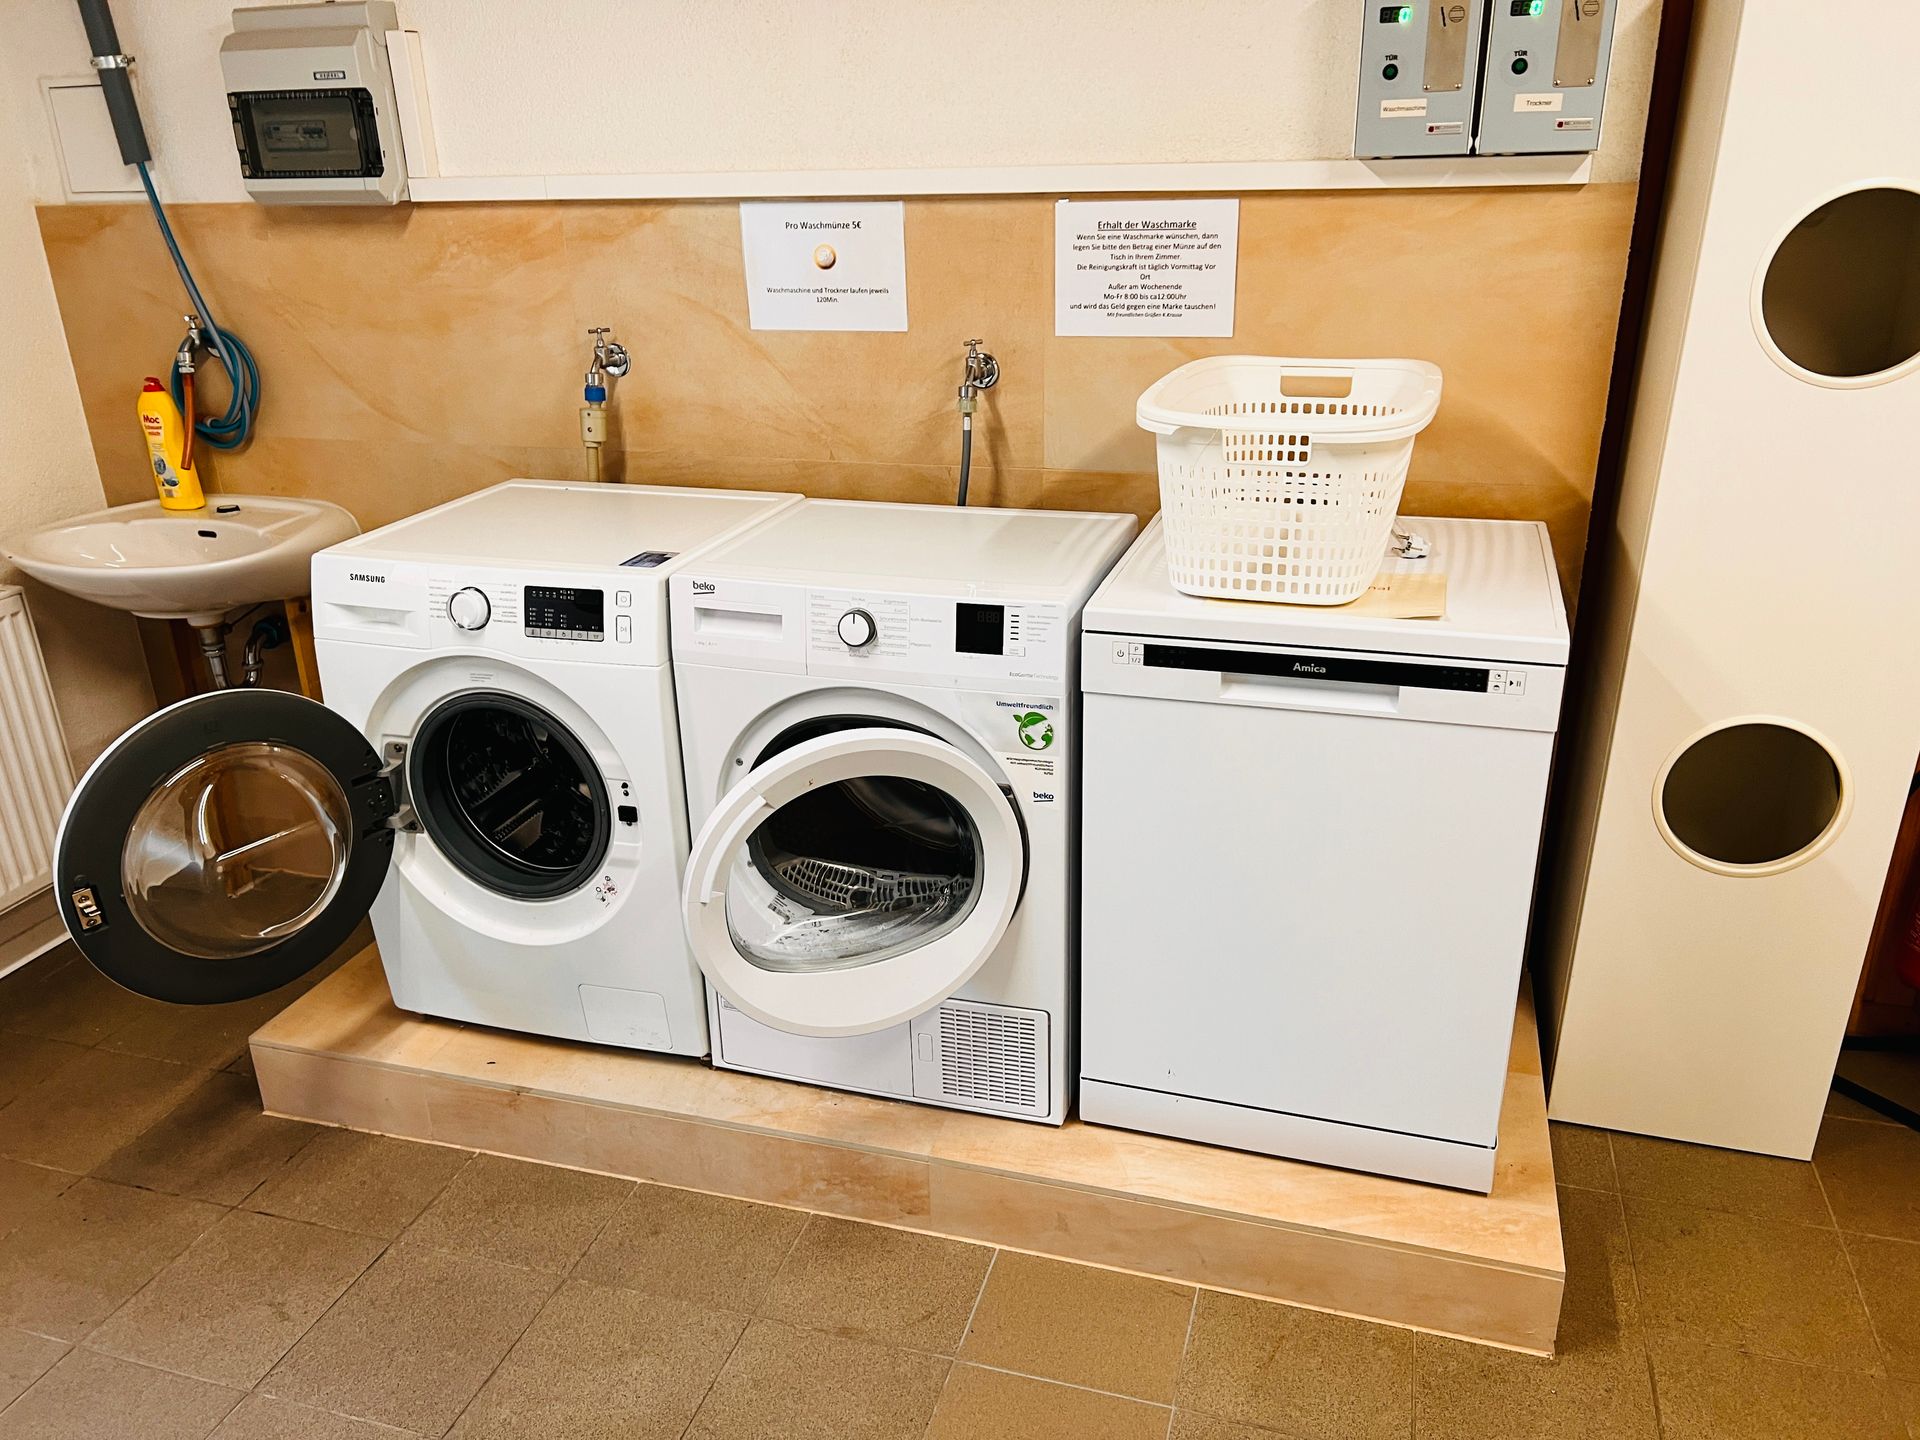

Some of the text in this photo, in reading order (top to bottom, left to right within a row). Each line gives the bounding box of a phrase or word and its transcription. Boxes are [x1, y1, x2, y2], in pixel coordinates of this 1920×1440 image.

[852, 221, 861, 229] 5€
[1098, 220, 1197, 229] Erhalt der Waschmarke
[143, 414, 160, 424] Moc
[349, 573, 386, 584] SAMSUNG
[693, 580, 715, 591] beko
[1292, 662, 1327, 674] Amica
[996, 701, 1054, 710] Umweltfreundlich
